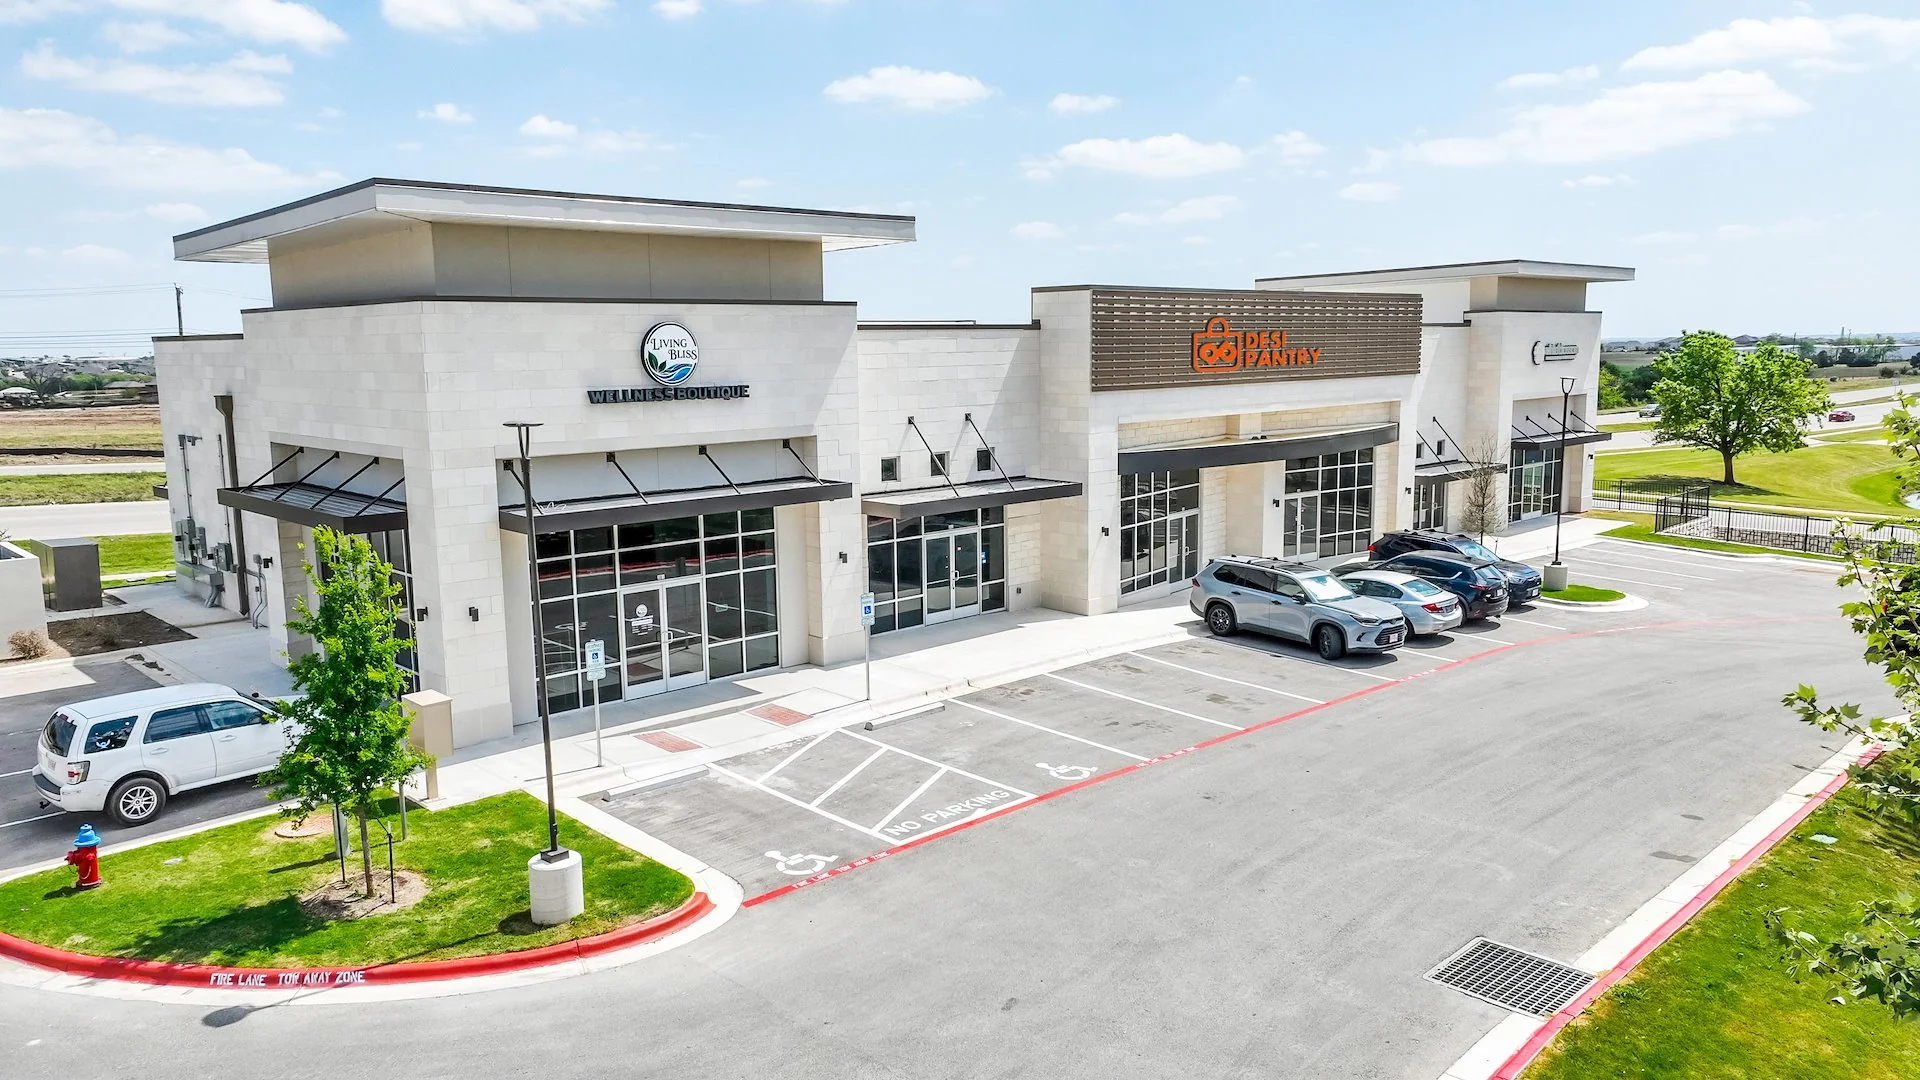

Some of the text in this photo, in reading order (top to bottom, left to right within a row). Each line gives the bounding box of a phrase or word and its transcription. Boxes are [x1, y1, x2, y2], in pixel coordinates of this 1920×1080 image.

[1244, 331, 1287, 349] DESI
[1244, 348, 1322, 368] PANTRY
[588, 385, 750, 404] WELLNESS BOUTIQUE
[884, 790, 1010, 836] NO PARKING
[210, 971, 366, 986] FIRE LANE TOW AWAY ZONE
